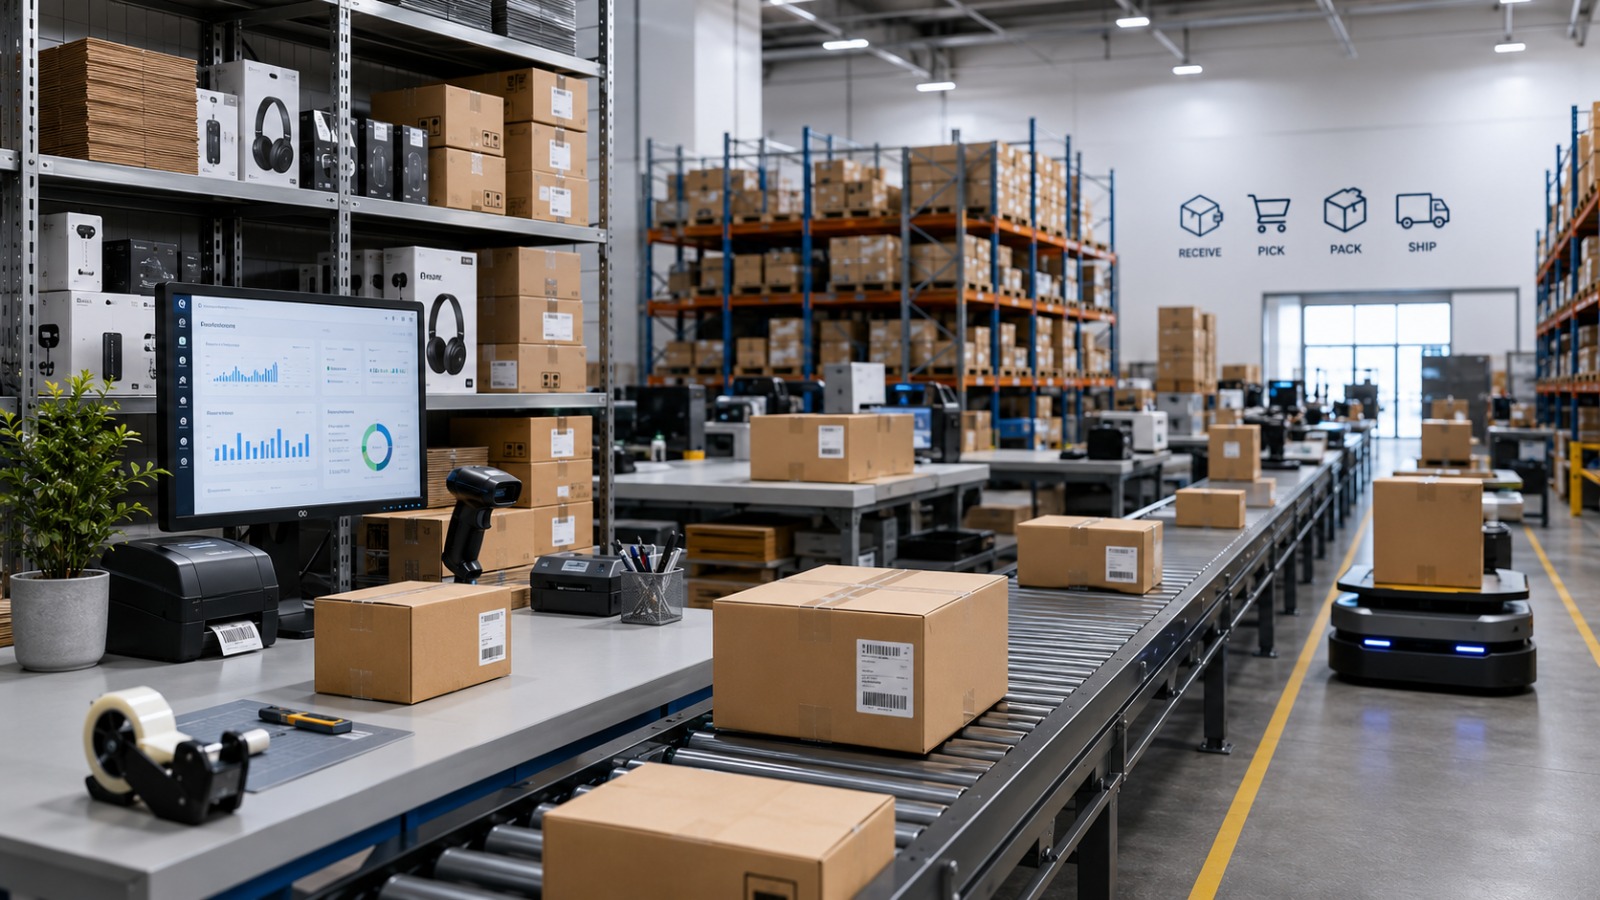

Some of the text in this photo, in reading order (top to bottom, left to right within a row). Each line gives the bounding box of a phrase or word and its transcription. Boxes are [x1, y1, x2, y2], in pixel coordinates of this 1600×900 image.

[1258, 245, 1285, 256] PICK
[1330, 244, 1362, 254] PACK
[1408, 242, 1437, 252] SHIP
[1179, 247, 1222, 258] RECEIVE
